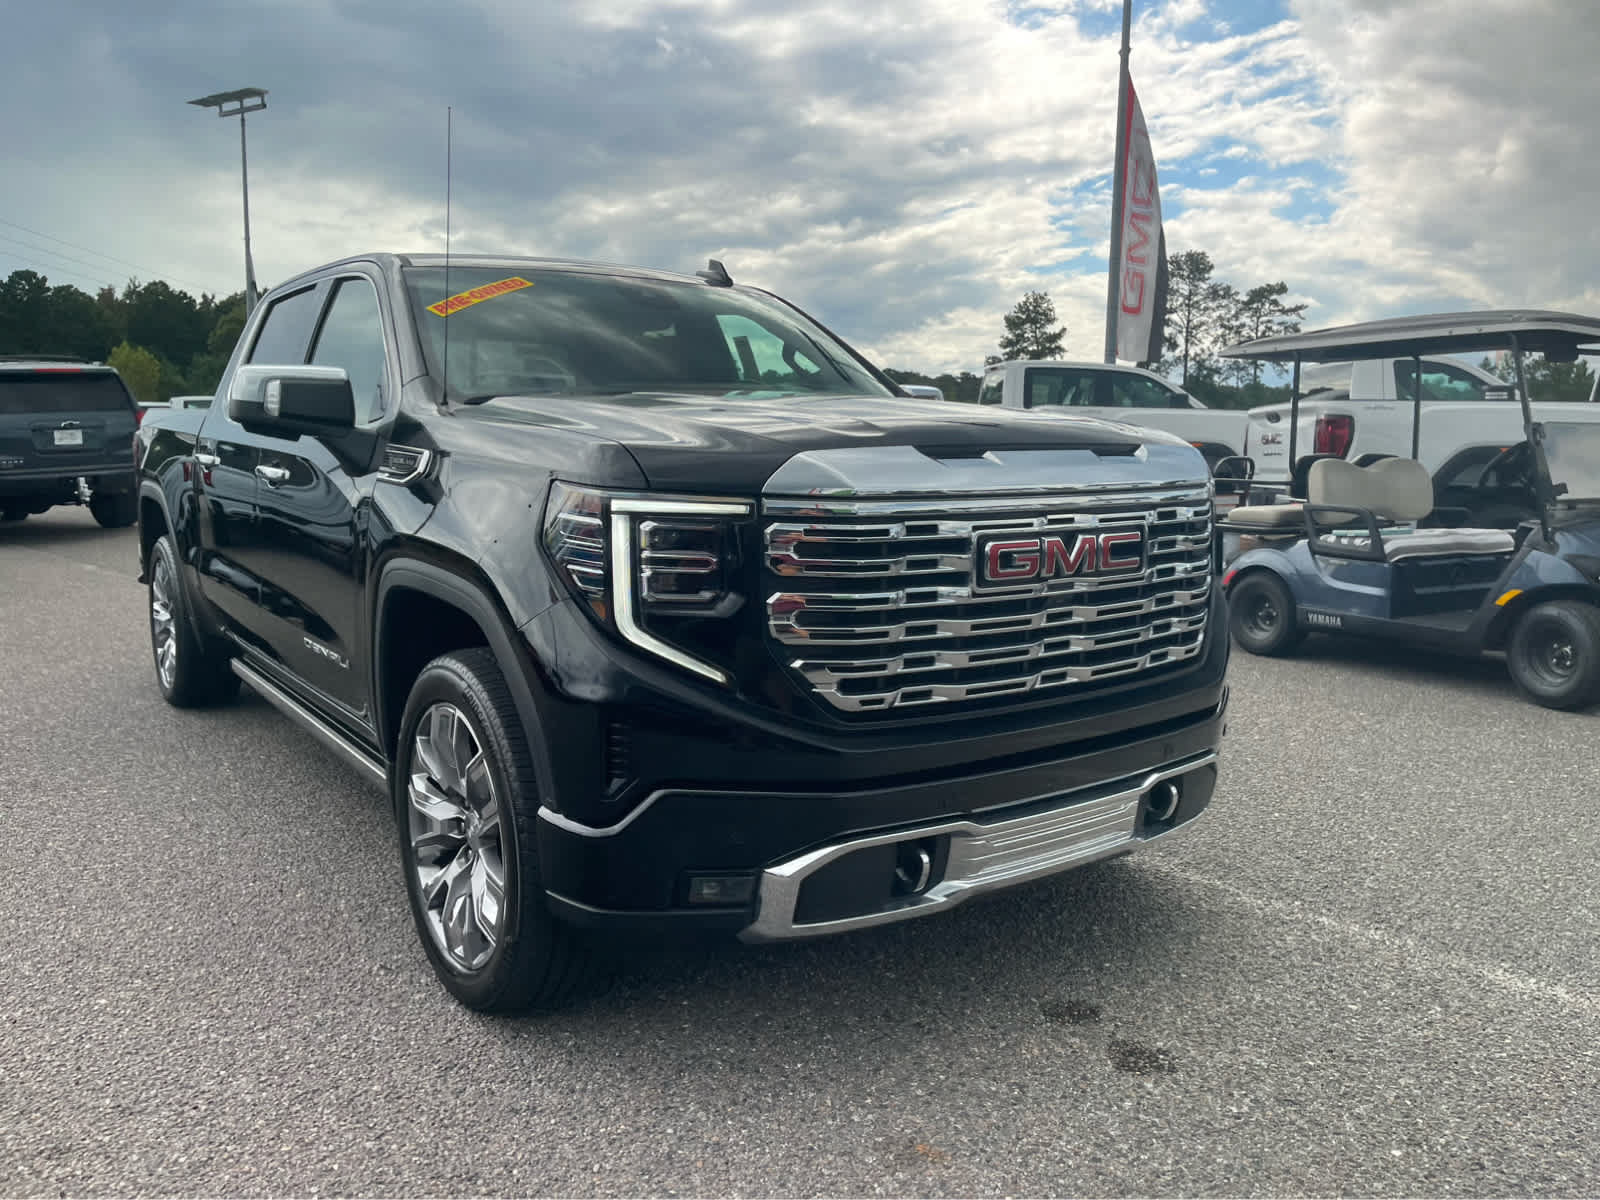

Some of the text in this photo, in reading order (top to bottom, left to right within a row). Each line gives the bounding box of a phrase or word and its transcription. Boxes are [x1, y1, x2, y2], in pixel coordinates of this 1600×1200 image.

[1121, 158, 1155, 316] GMC
[431, 278, 528, 315] PRE-OWNED
[985, 532, 1141, 581] GMC
[1307, 611, 1342, 626] YAMAHA
